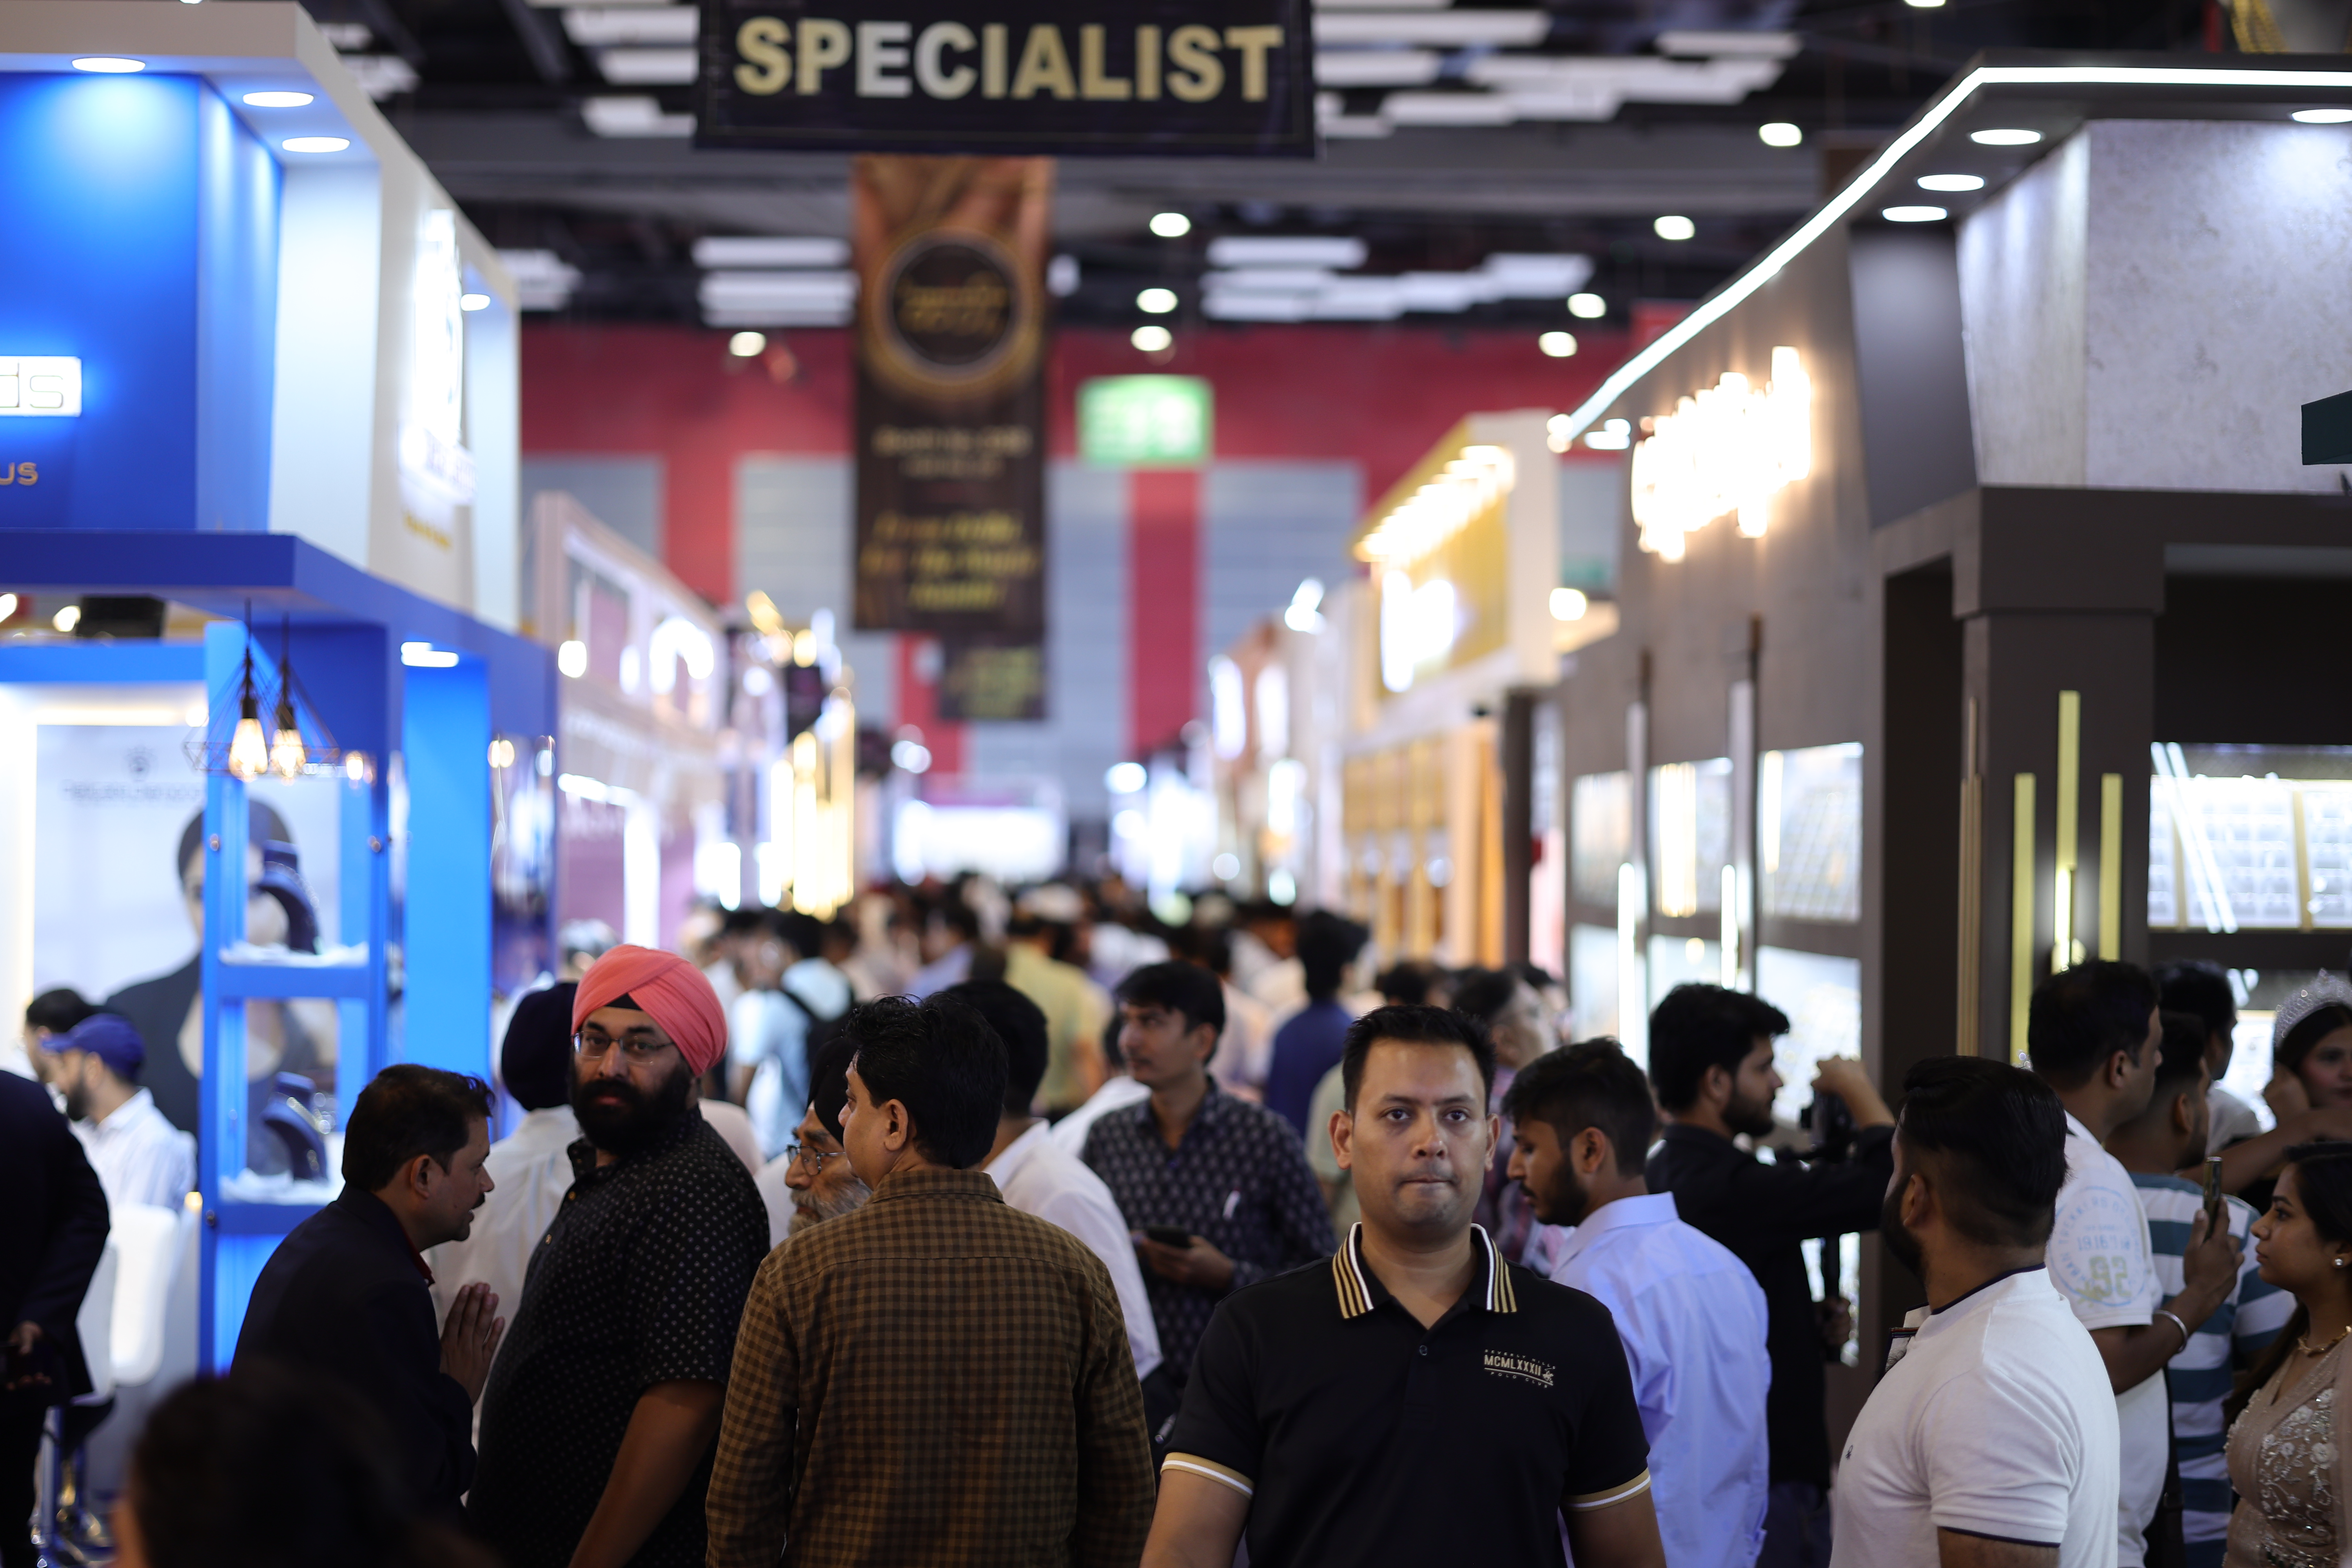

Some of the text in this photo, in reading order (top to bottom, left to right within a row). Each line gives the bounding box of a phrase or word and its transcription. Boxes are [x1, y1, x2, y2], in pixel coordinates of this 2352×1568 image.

[733, 15, 1285, 103] SPECIALIST
[0, 462, 38, 486] US
[1484, 1349, 1556, 1370] BEVERLY HILLS
[1484, 1354, 1541, 1376] MCMLXXXII
[1525, 1377, 1548, 1388] CLUB
